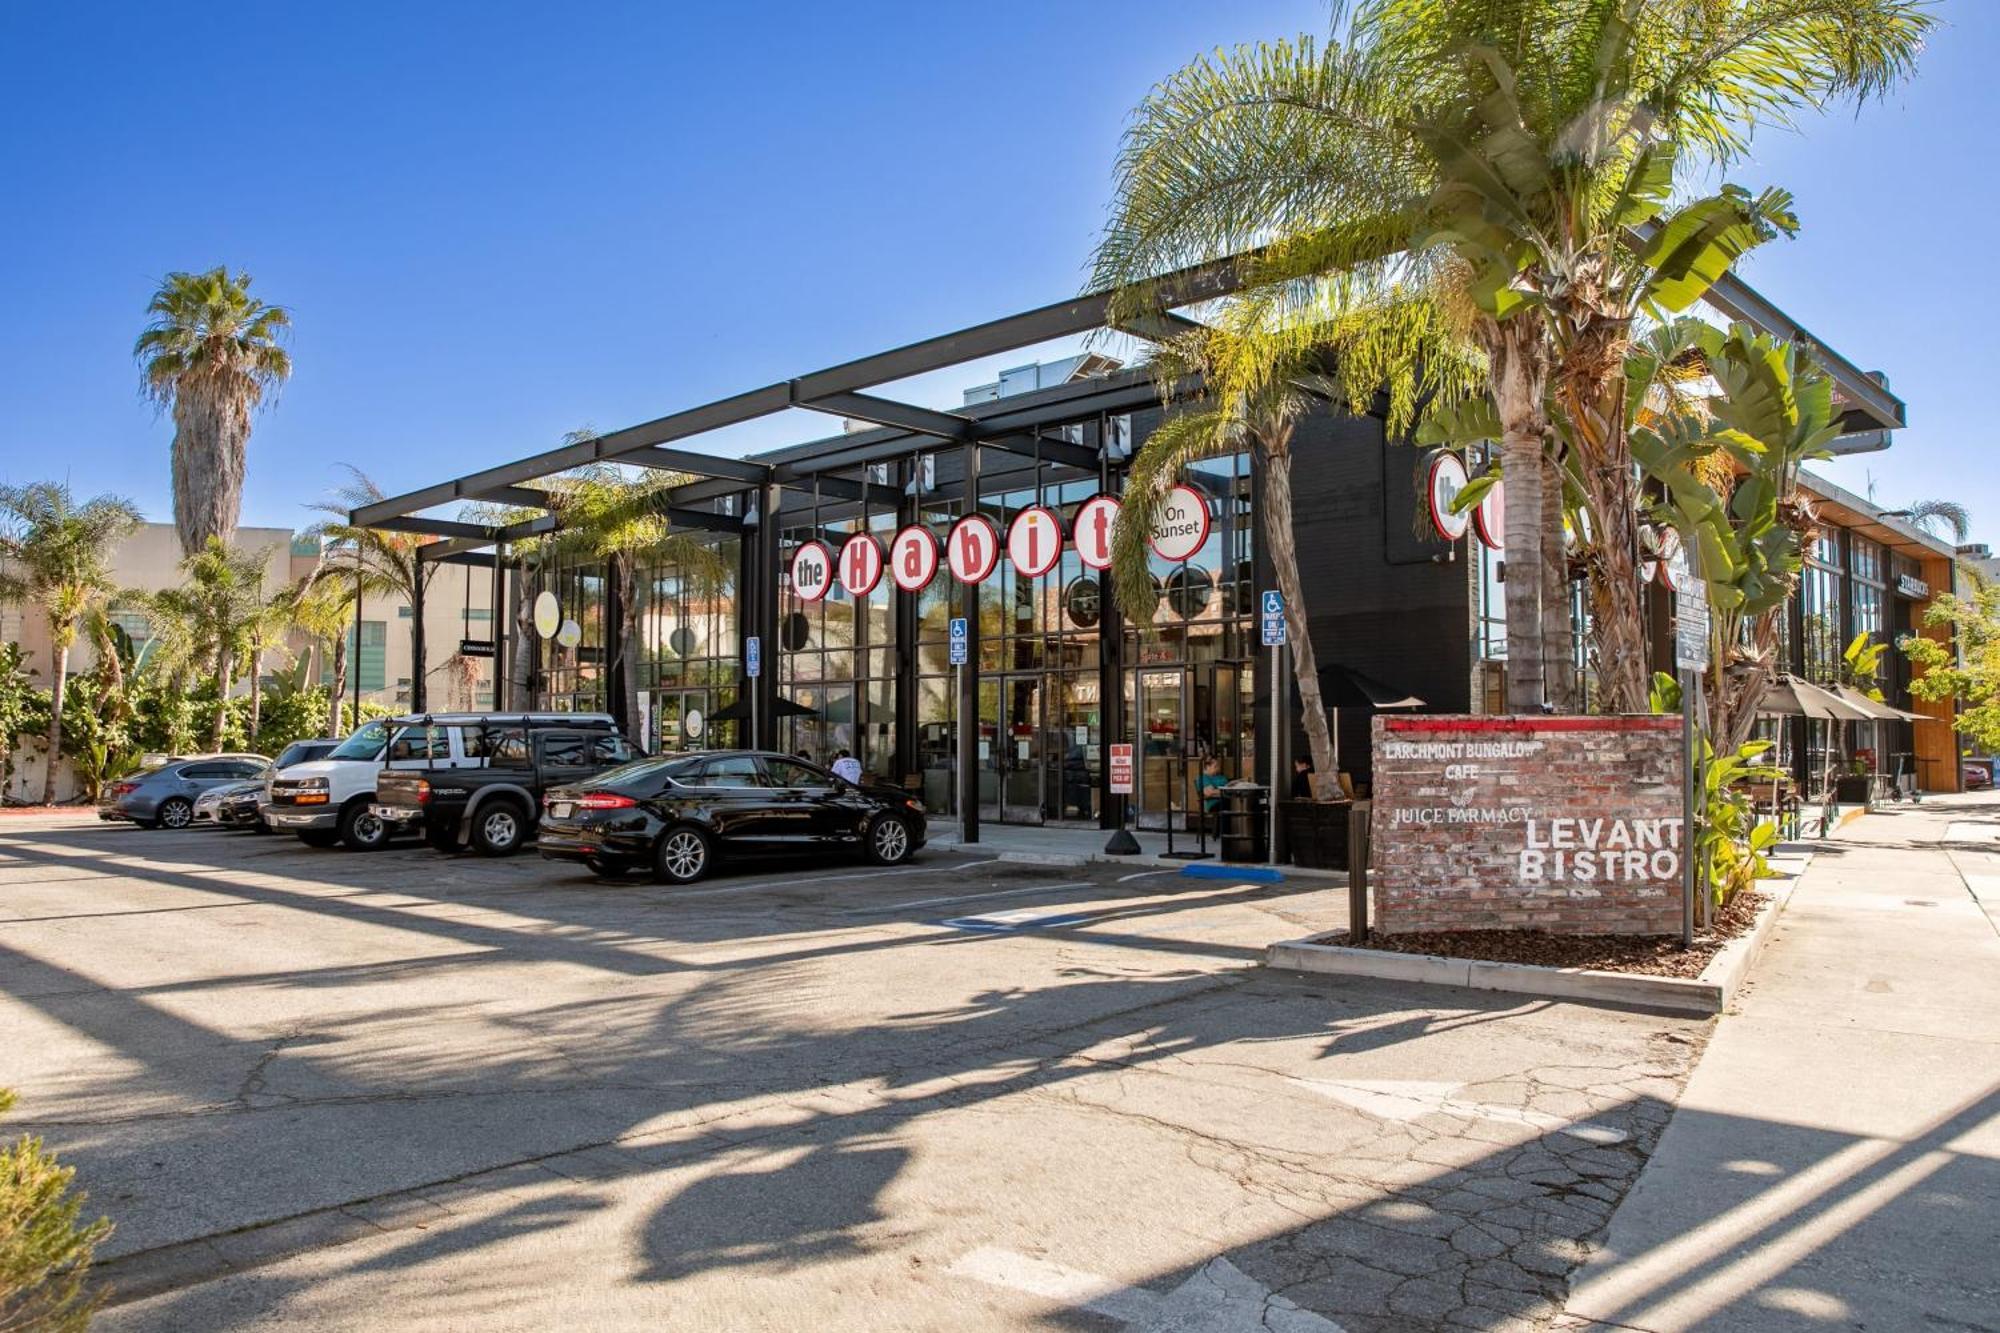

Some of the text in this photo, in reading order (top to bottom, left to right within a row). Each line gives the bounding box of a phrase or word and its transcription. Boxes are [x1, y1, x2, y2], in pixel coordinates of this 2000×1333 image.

[1165, 506, 1185, 521] On
[1152, 520, 1200, 540] Sunset
[797, 558, 823, 587] the
[1385, 741, 1464, 759] LARCHMONT
[1445, 764, 1480, 779] CAFE
[1390, 807, 1534, 825] JUICE FARMACY
[1526, 817, 1685, 850] LEVANT
[1519, 850, 1680, 882] BISTRO
